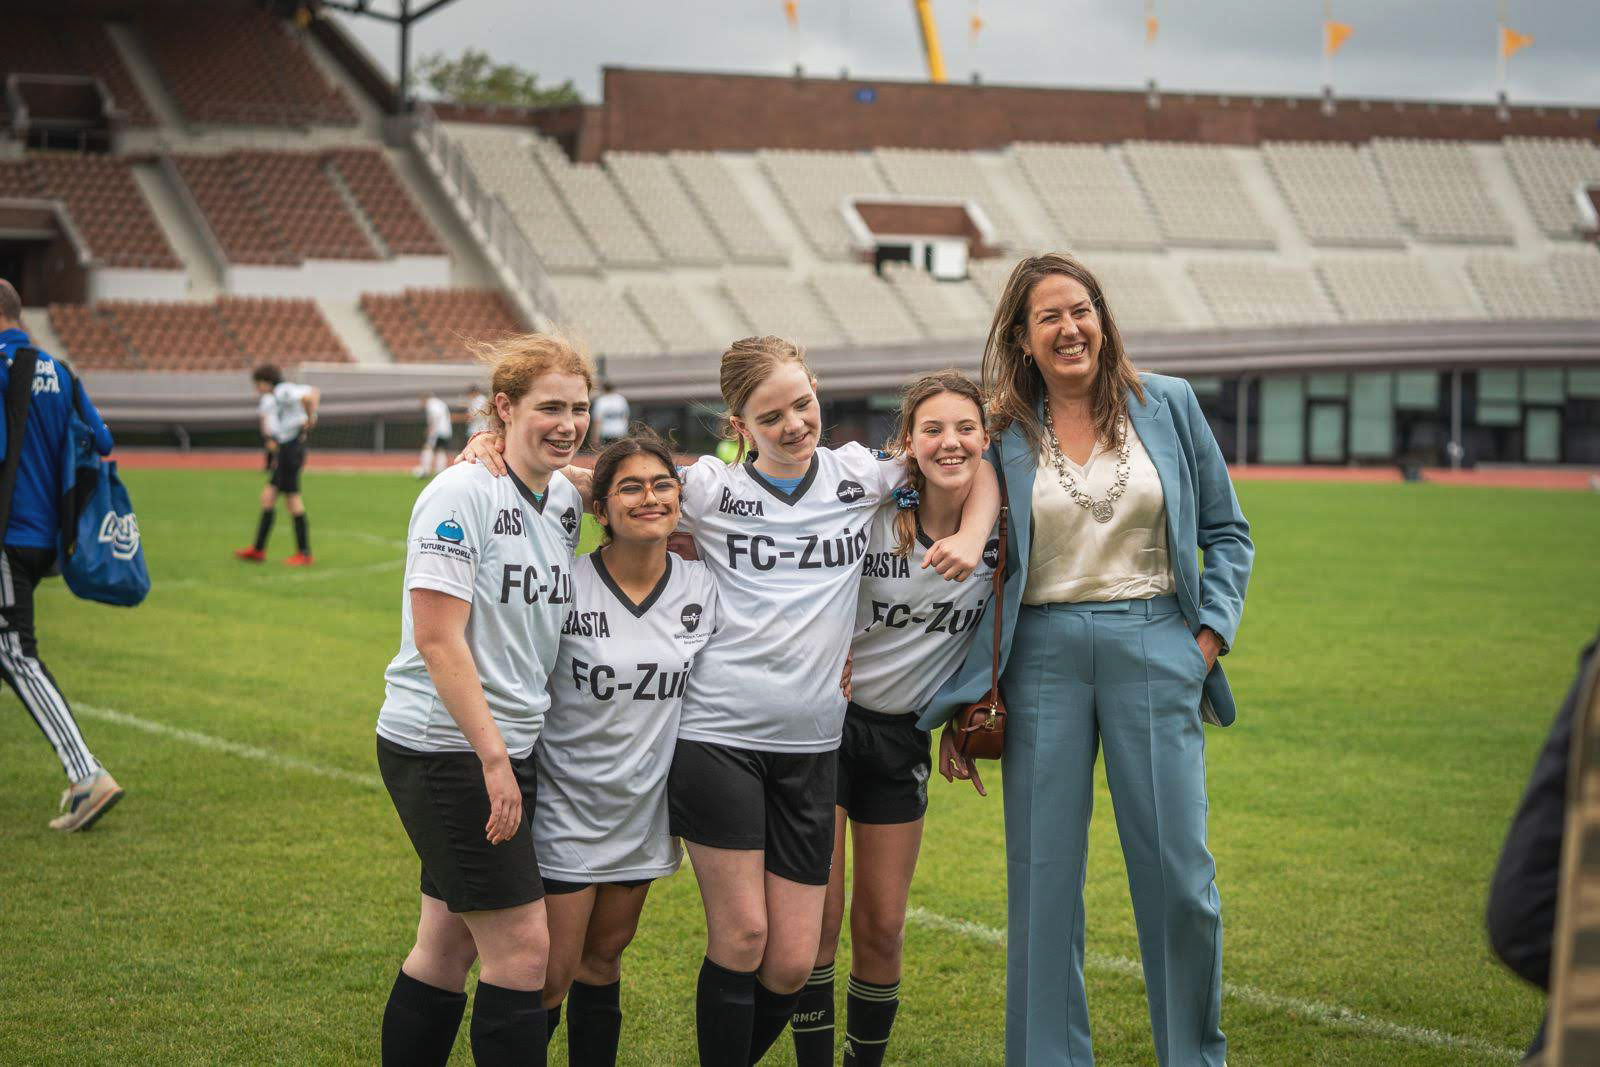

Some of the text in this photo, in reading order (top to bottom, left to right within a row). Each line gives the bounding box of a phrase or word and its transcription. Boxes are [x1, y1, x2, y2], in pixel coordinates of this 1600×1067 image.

[718, 486, 764, 517] BASTA
[420, 542, 446, 552] FUTURE
[861, 552, 910, 578] BASTA
[560, 610, 611, 638] BASTA
[864, 599, 988, 635] FC-Zui
[571, 656, 692, 701] FC-Zui
[792, 1009, 826, 1023] RMCF
